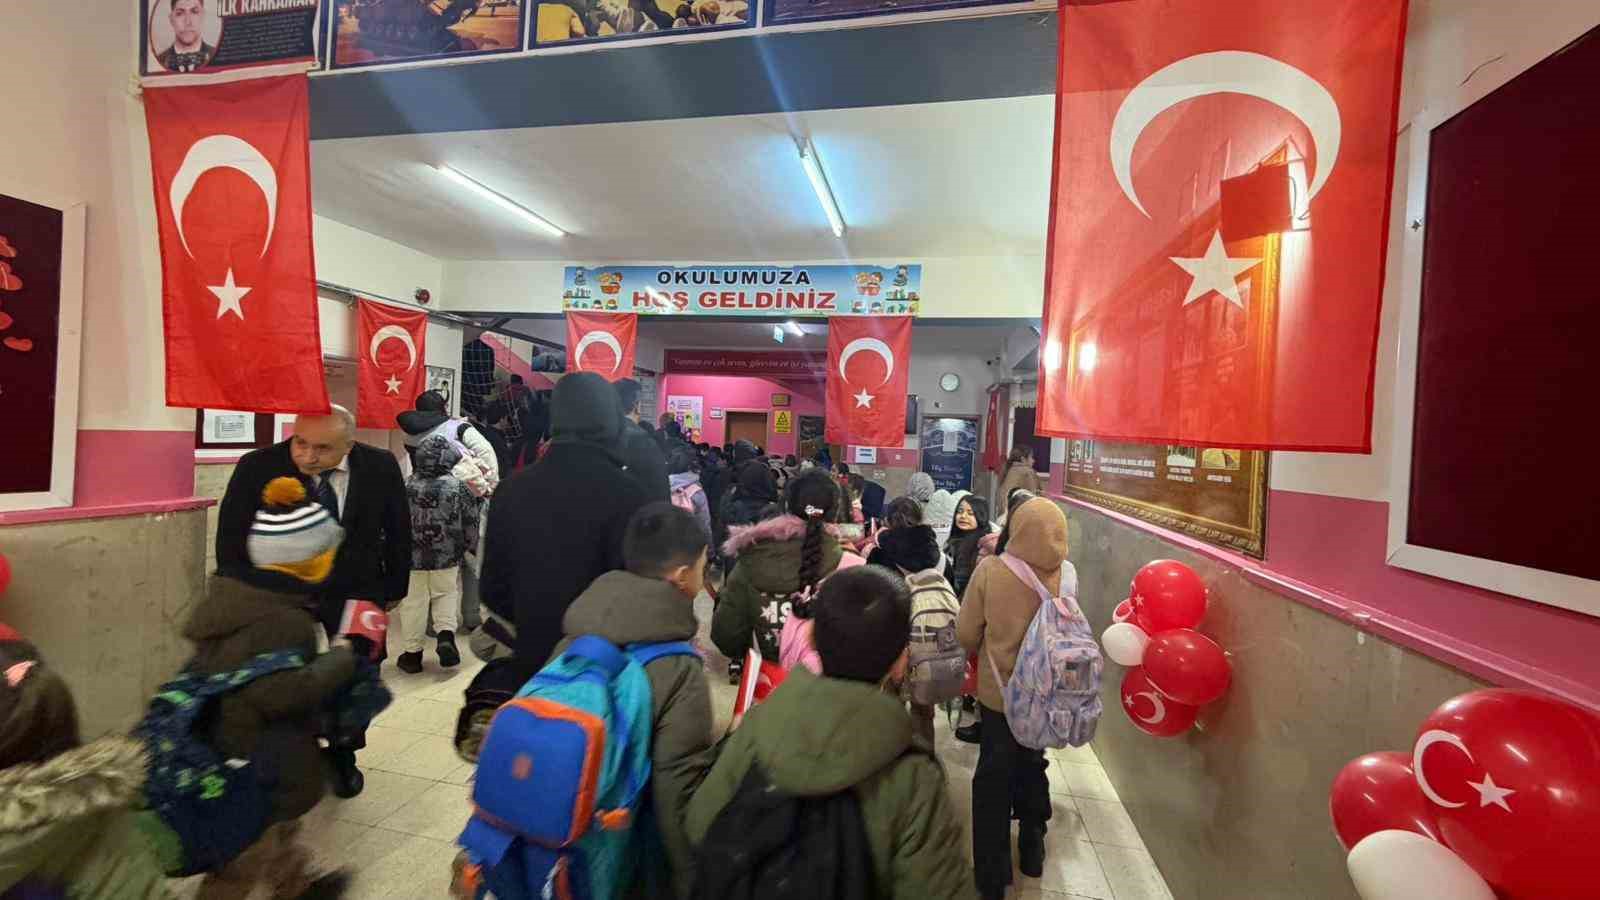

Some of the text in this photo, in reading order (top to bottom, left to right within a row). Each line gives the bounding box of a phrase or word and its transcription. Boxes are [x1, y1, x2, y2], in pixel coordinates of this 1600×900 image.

[657, 270, 811, 285] OKULUMUZA
[632, 288, 837, 310] HOŞ GELDİNİZ
